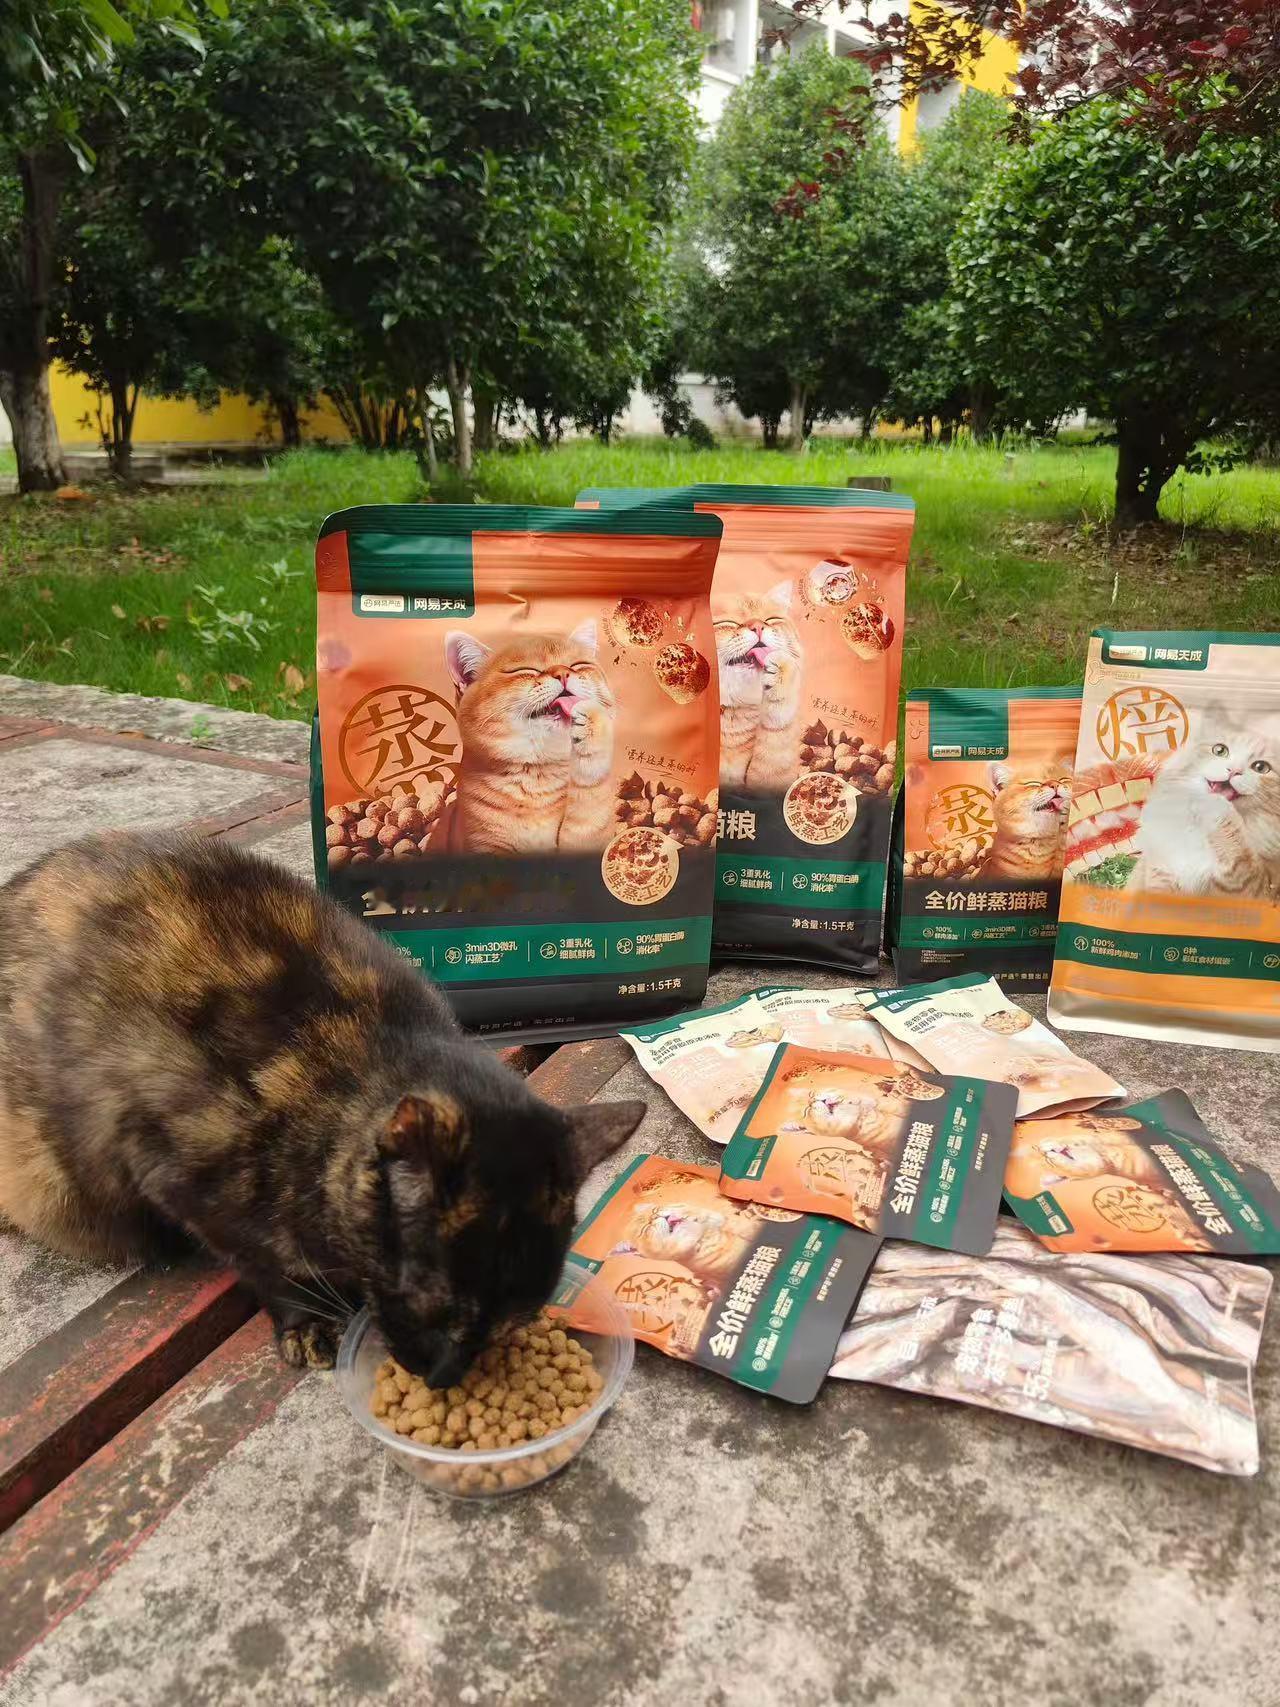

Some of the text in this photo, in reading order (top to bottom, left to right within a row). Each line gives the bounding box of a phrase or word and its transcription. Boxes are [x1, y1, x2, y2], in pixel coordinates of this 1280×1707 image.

[414, 598, 466, 611] 网易天成
[1154, 648, 1203, 661] 网易天成
[925, 890, 1048, 912] 全价鲜蒸猫粮
[560, 938, 593, 948] 3重乳化
[1091, 938, 1115, 948] 100%
[890, 1121, 934, 1215] 全价鲜蒸猫粮
[709, 1245, 782, 1359] 全价鲜蒸猫粮
